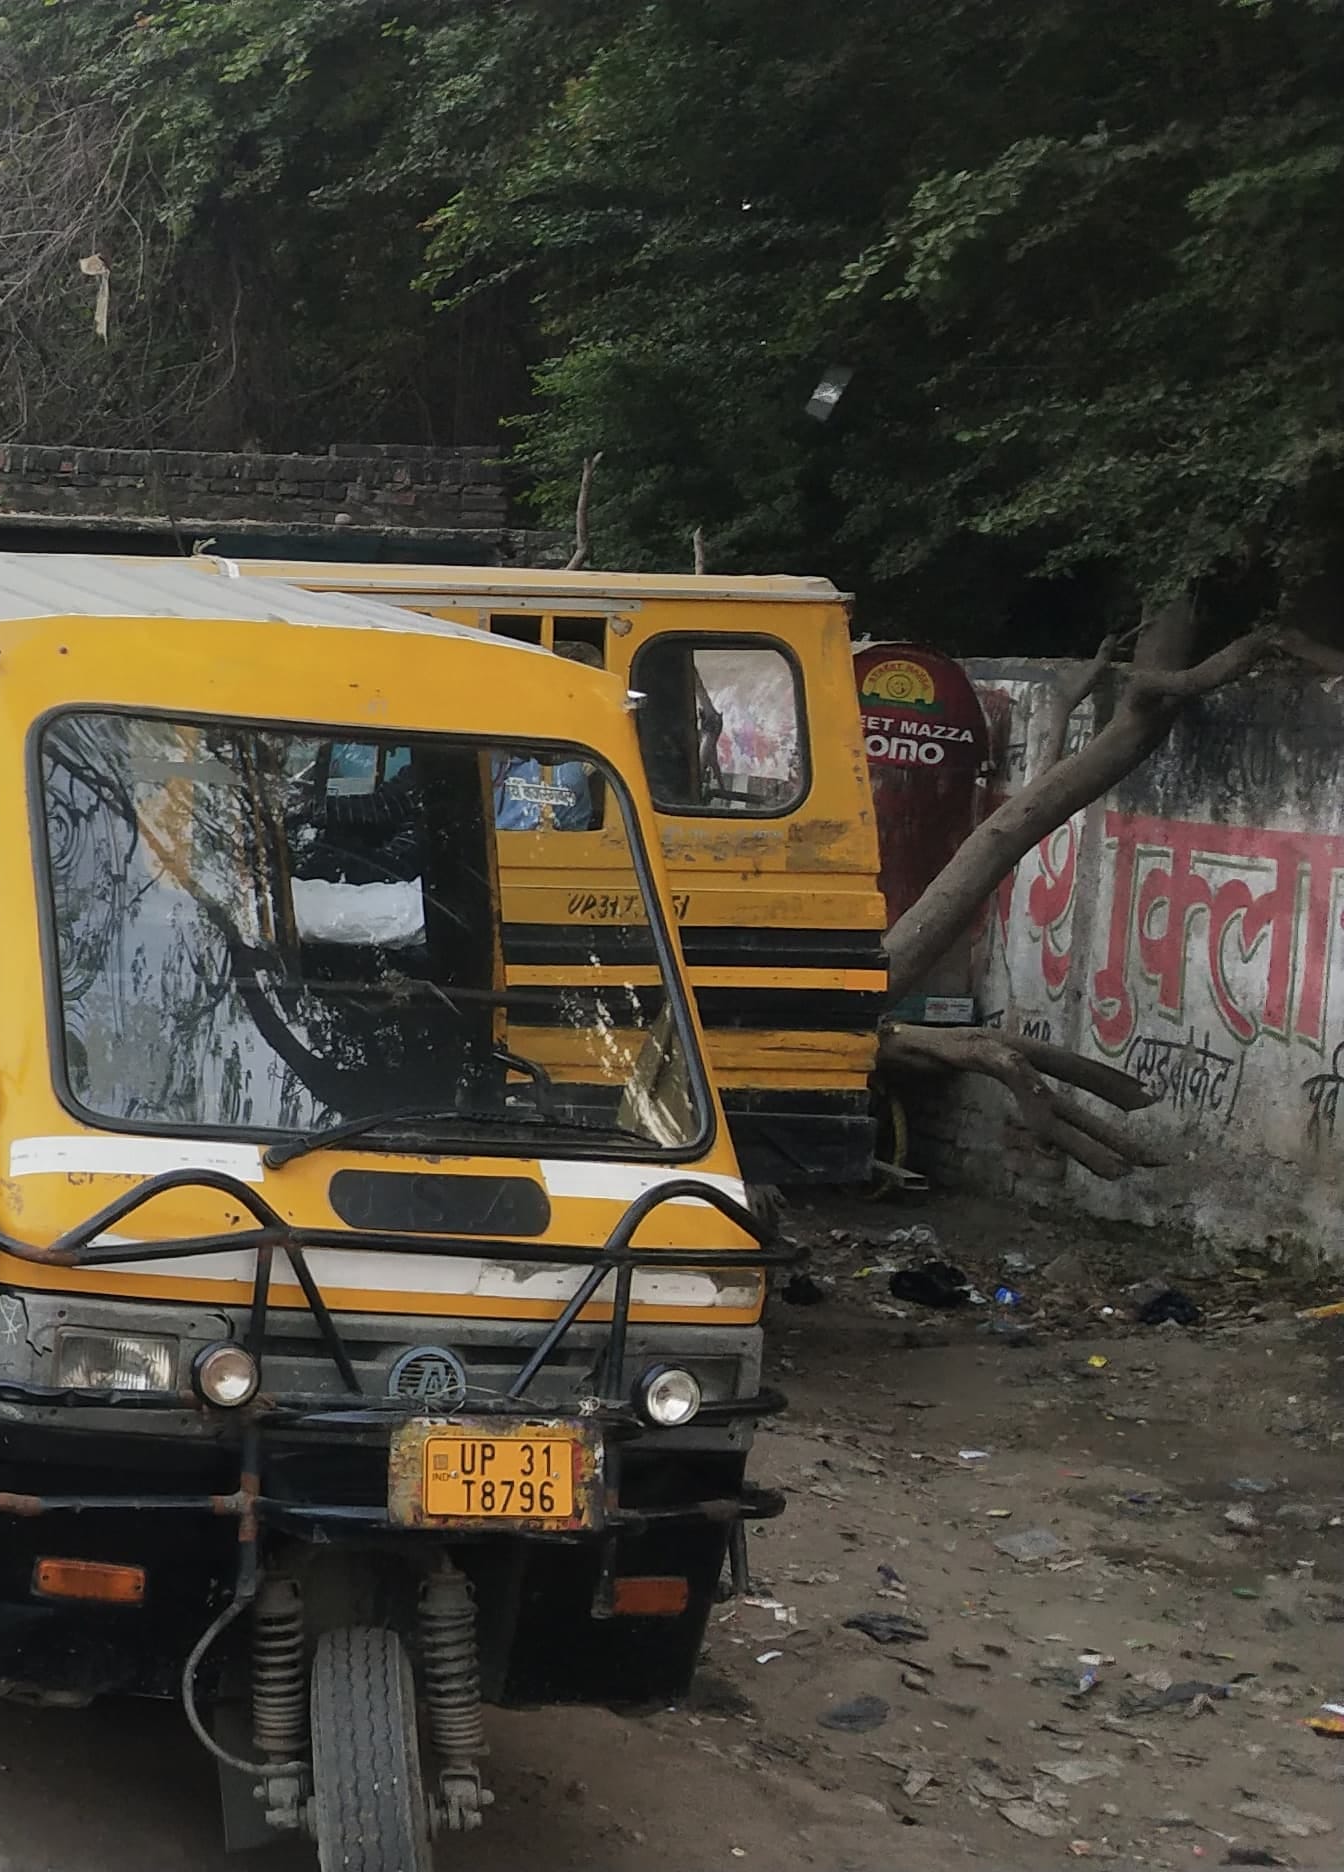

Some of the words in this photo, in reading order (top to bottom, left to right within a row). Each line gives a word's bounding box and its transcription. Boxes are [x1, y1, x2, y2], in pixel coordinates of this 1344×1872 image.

[900, 720, 974, 743] MAZZA
[865, 734, 944, 764] OMO
[460, 1442, 496, 1476] UP
[519, 1444, 552, 1477] 31
[461, 1480, 555, 1513] T8796
